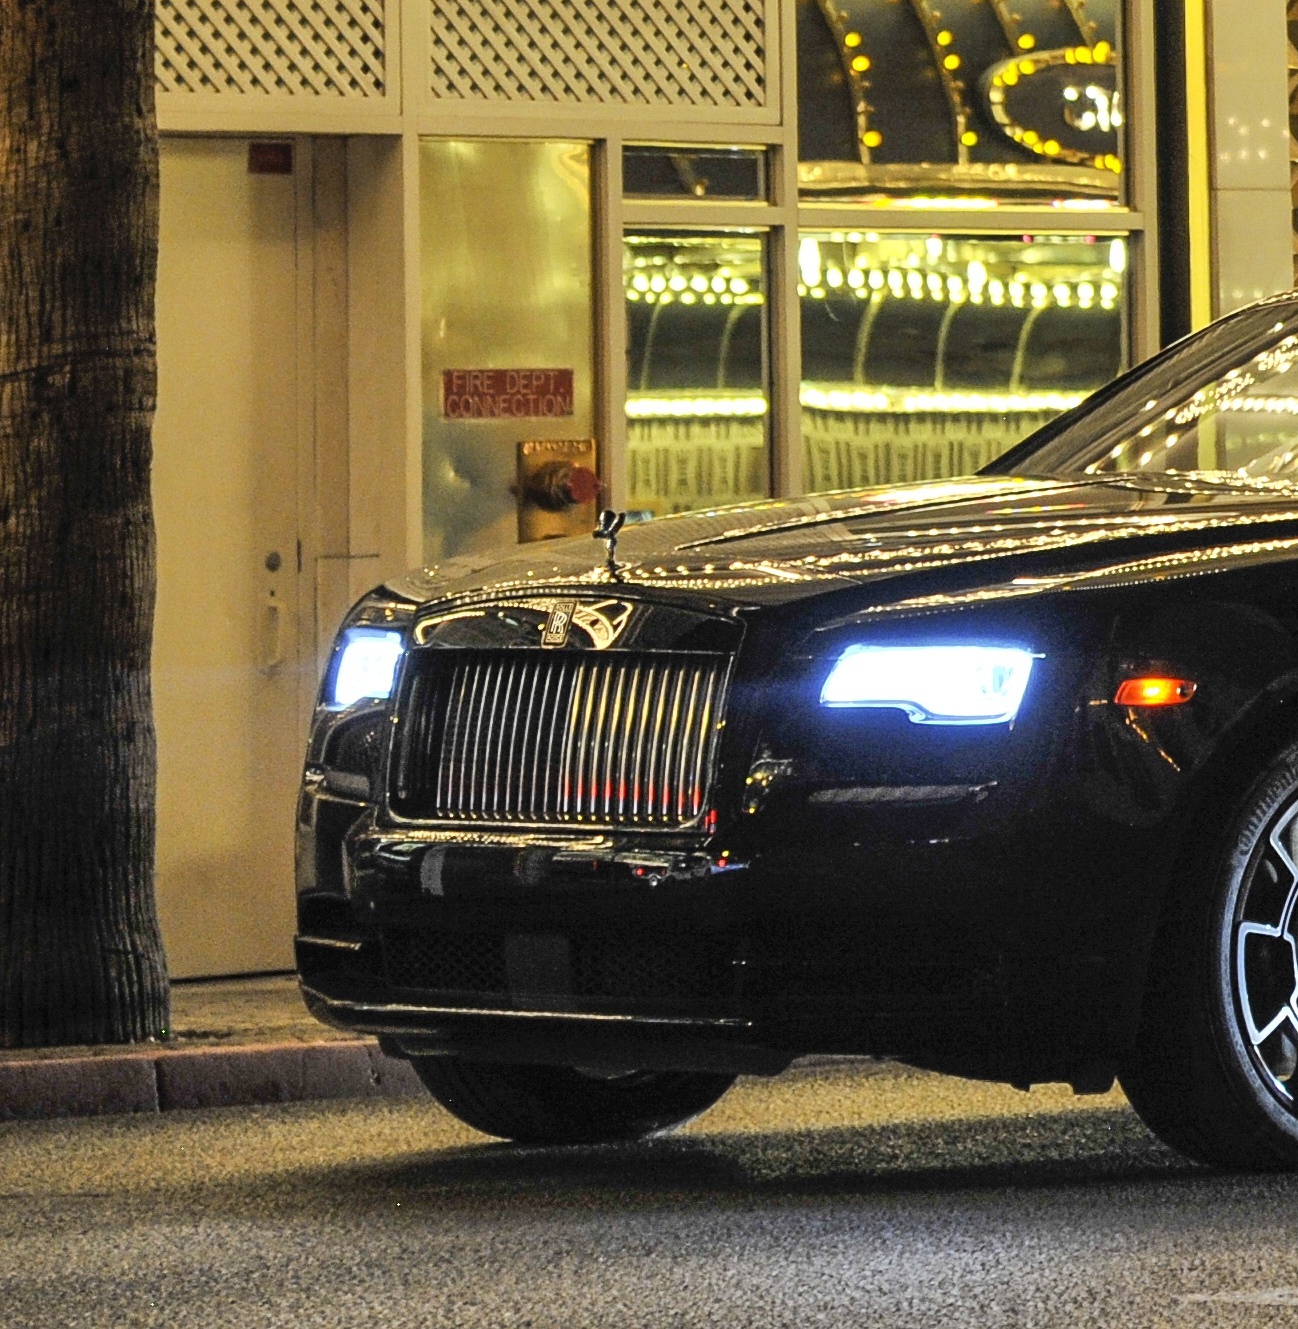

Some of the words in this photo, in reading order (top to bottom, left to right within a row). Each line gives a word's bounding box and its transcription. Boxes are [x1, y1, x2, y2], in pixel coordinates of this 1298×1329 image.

[452, 371, 495, 393] FIRE
[506, 370, 565, 393] DEPT.
[446, 394, 571, 417] CONNECTION
